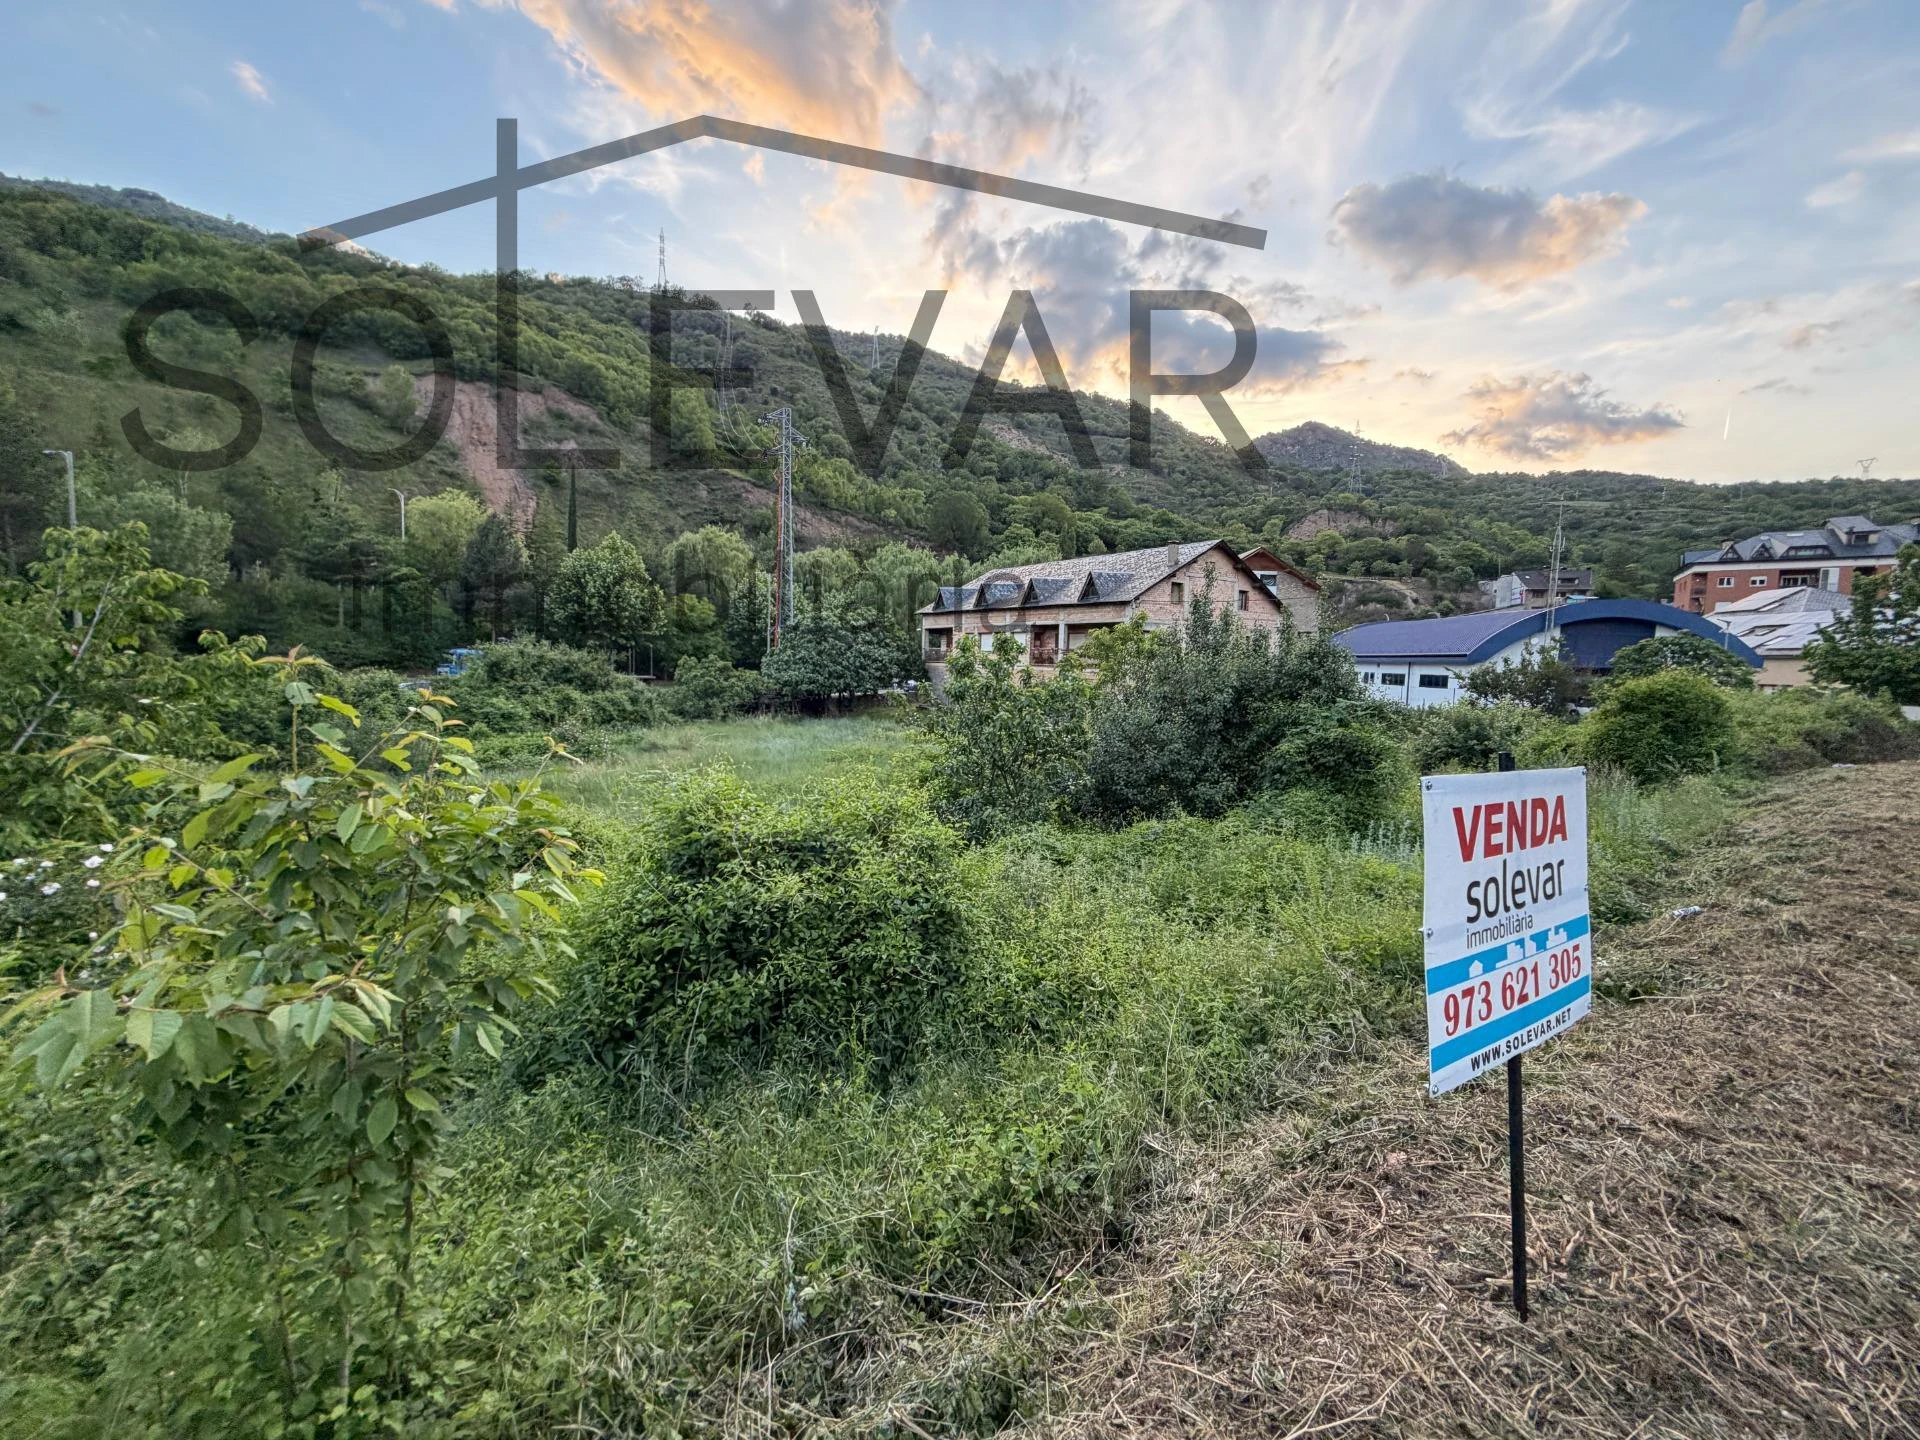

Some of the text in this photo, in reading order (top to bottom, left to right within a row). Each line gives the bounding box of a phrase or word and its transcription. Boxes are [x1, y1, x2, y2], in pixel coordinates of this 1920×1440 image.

[1453, 795, 1568, 863] VENDA
[1466, 858, 1565, 924] solevar
[1466, 912, 1534, 950] immobiliària
[1444, 943, 1582, 1037] 973 621 305
[1471, 1007, 1572, 1072] WWW.SOLEVAR.NET
